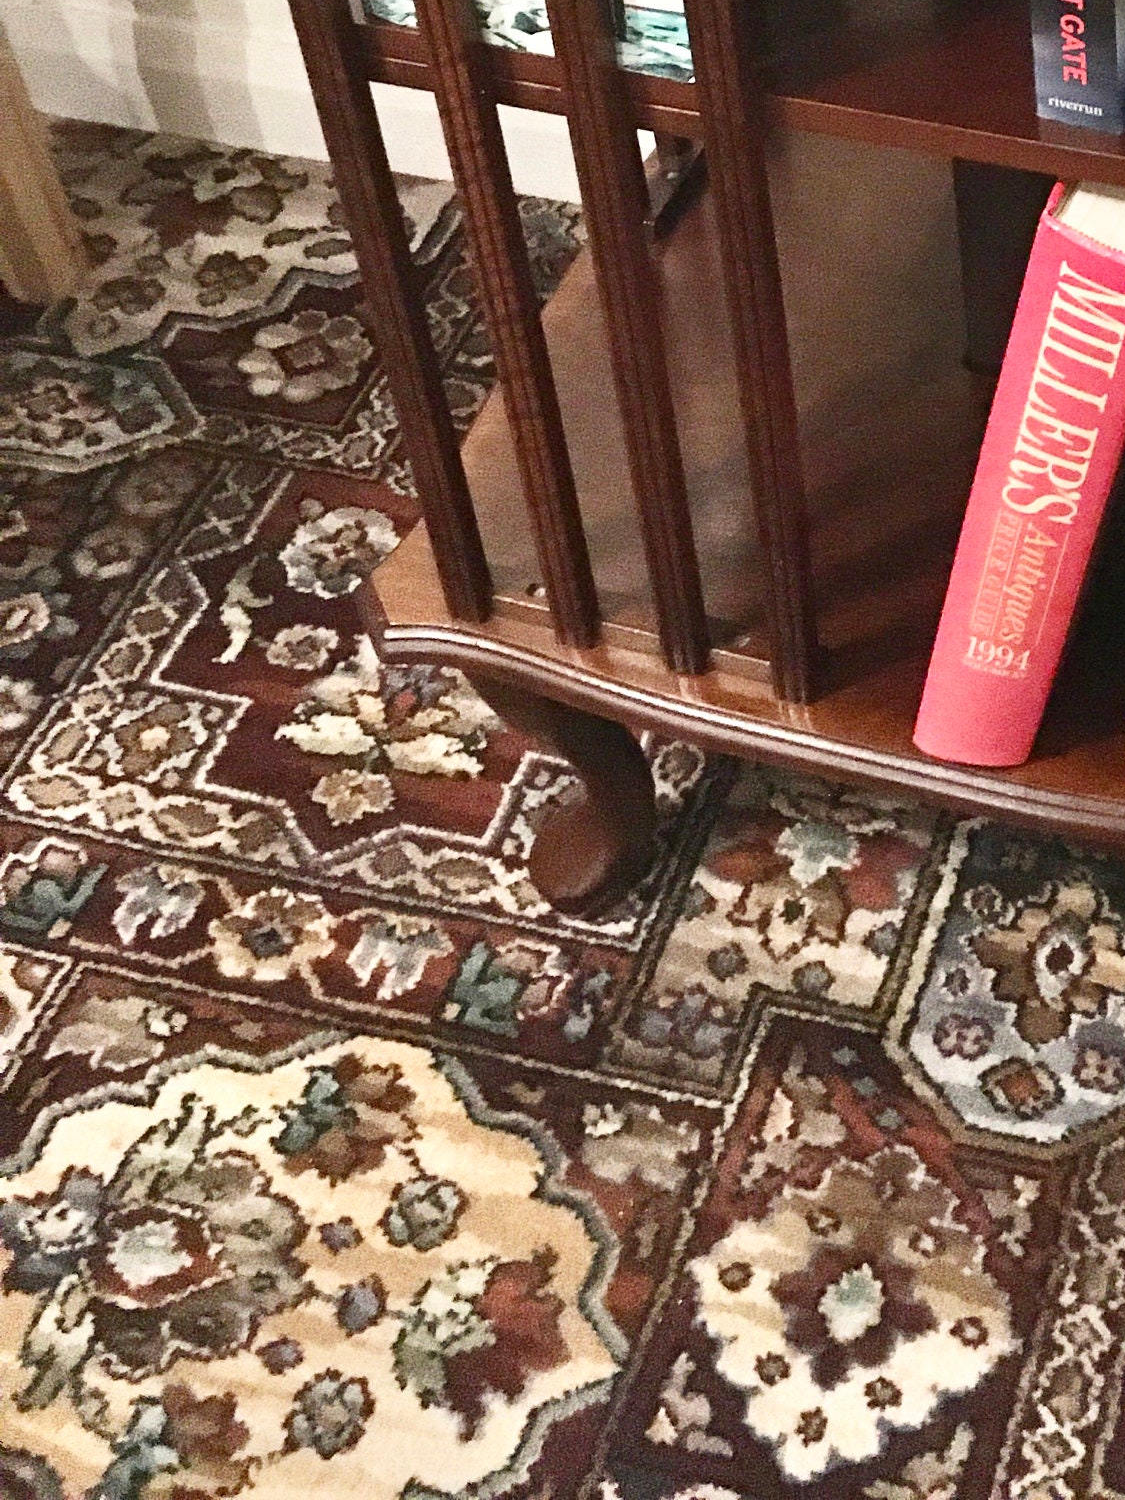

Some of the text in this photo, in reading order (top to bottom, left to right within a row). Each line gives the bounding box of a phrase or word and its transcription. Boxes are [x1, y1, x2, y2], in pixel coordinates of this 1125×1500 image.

[1060, 14, 1087, 86] GATE
[1048, 97, 1103, 117] riverrun
[1001, 521, 1058, 645] Antiques
[966, 635, 1031, 670] 1994
